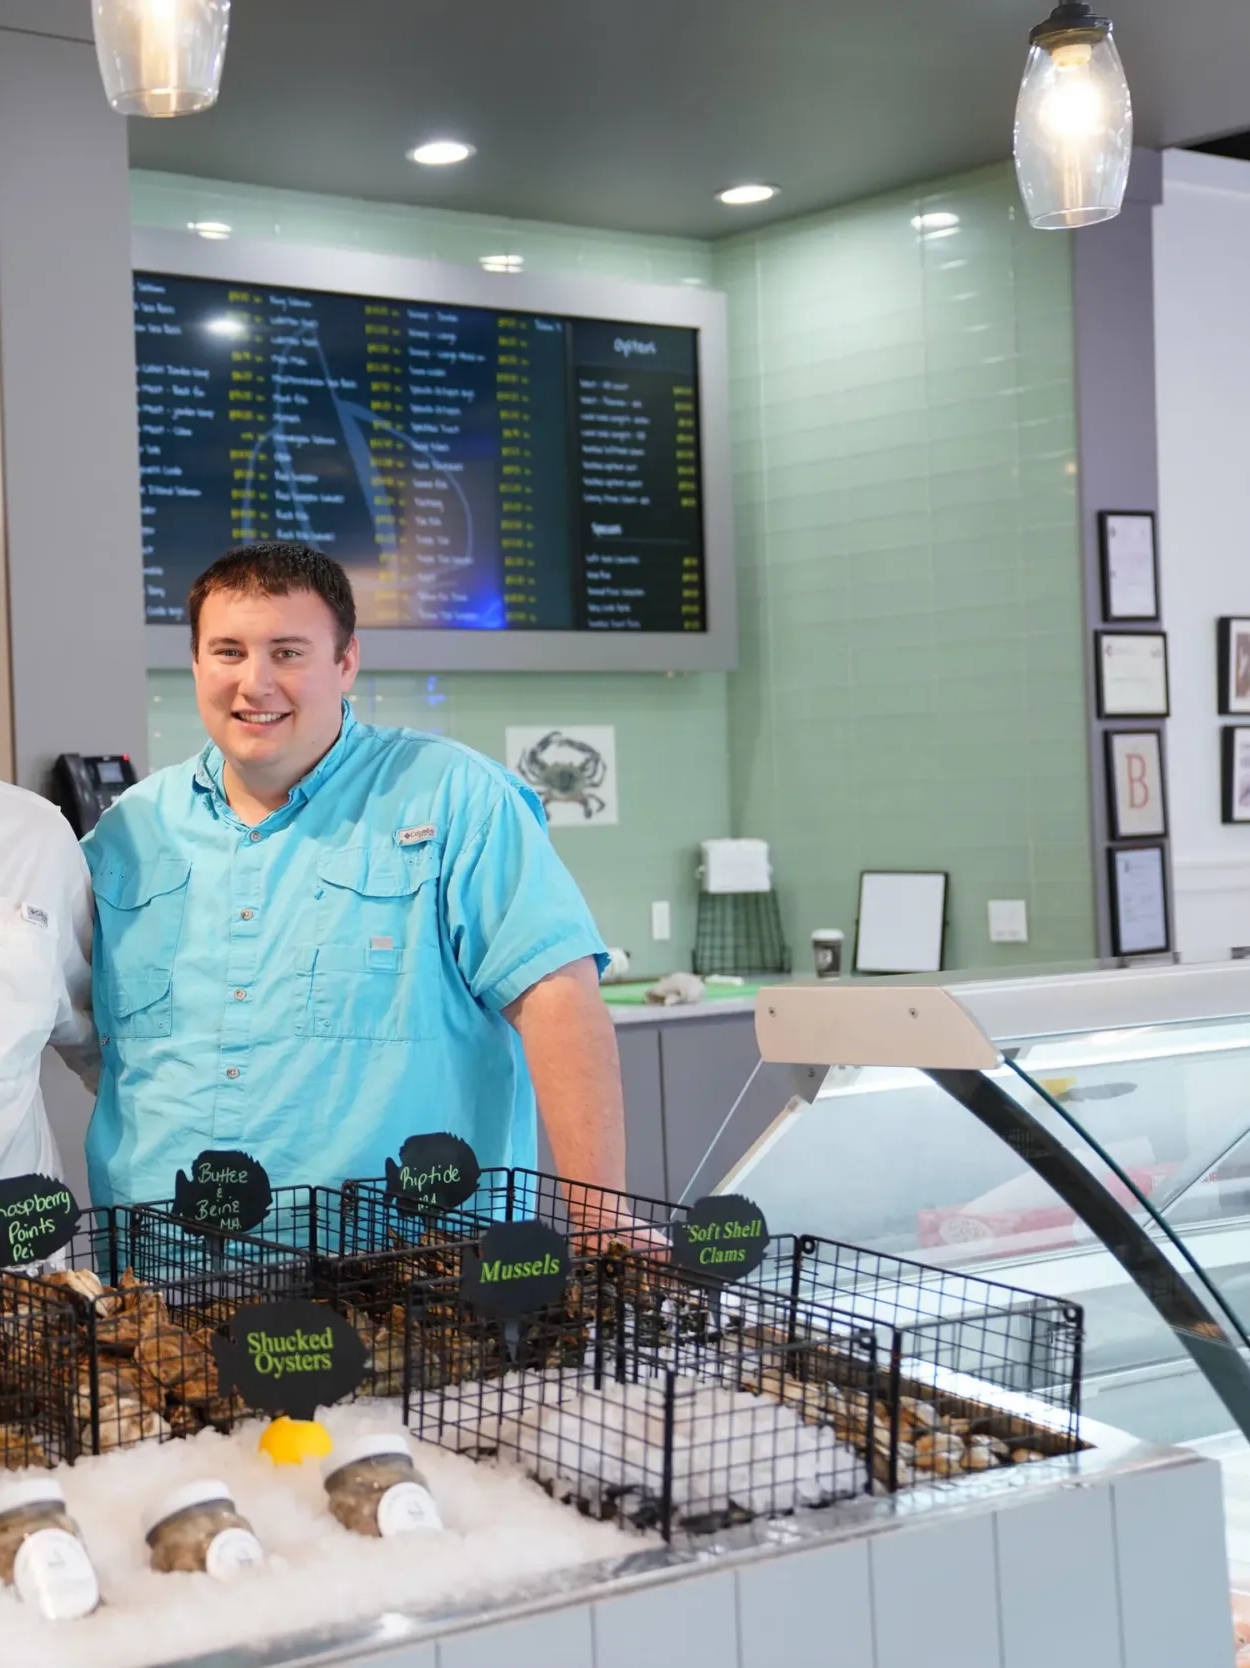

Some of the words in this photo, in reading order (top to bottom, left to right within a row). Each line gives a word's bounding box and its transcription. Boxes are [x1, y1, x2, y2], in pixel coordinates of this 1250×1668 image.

[1125, 752, 1149, 810] B
[400, 1164, 461, 1192] Riptide
[8, 1218, 55, 1244] Points
[689, 1222, 721, 1243] Soft
[722, 1220, 762, 1239] Shell
[479, 1253, 560, 1283] Mussels
[699, 1247, 746, 1264] Clams
[247, 1327, 334, 1354] Shucked
[255, 1351, 332, 1379] Oysters
